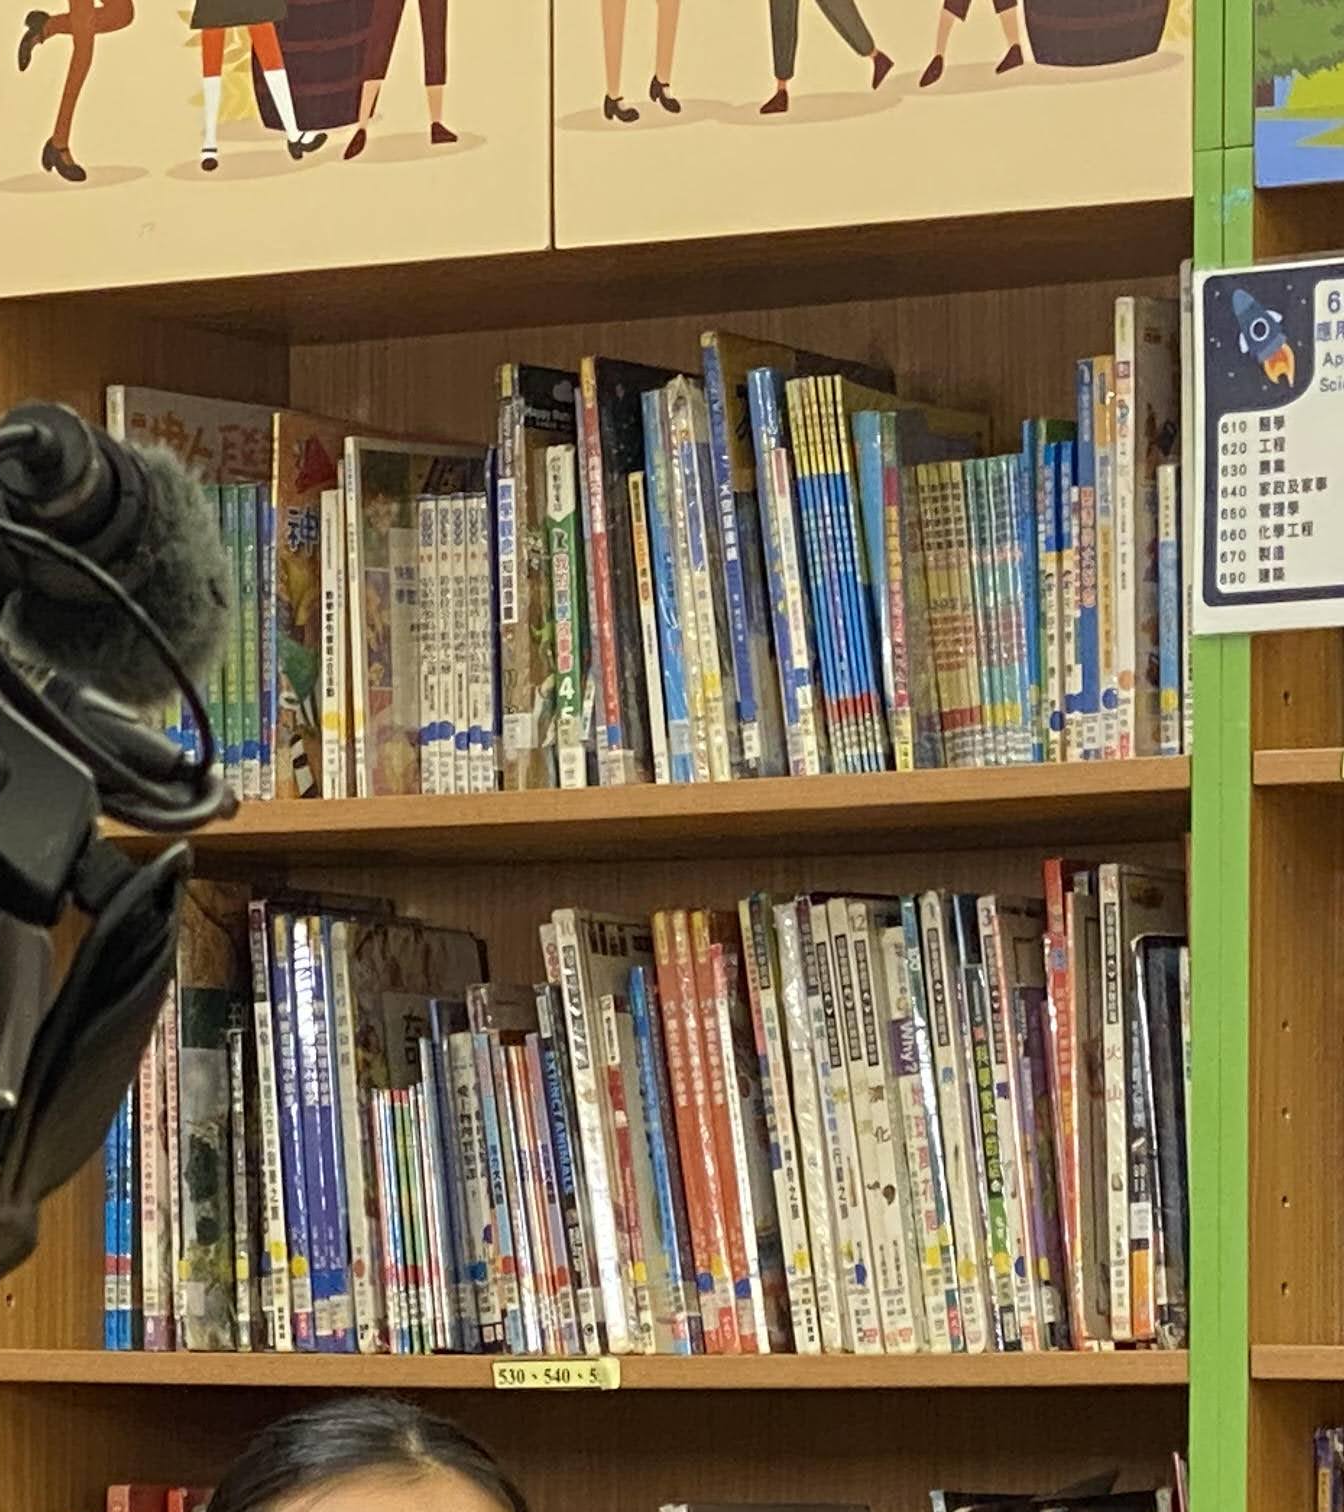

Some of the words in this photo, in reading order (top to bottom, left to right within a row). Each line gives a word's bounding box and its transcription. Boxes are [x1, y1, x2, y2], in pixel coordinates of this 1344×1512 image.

[1220, 420, 1247, 434] 610
[1220, 441, 1247, 455] 620
[1258, 437, 1286, 453] 工程
[1220, 463, 1247, 477] 630
[1220, 484, 1247, 498] 640
[1258, 521, 1314, 539] 化學工程
[1220, 549, 1247, 563] 670
[899, 1021, 918, 1074] Why?
[555, 1122, 574, 1195] ANIMALS
[498, 1368, 525, 1386] 530
[543, 1368, 570, 1384] 540
